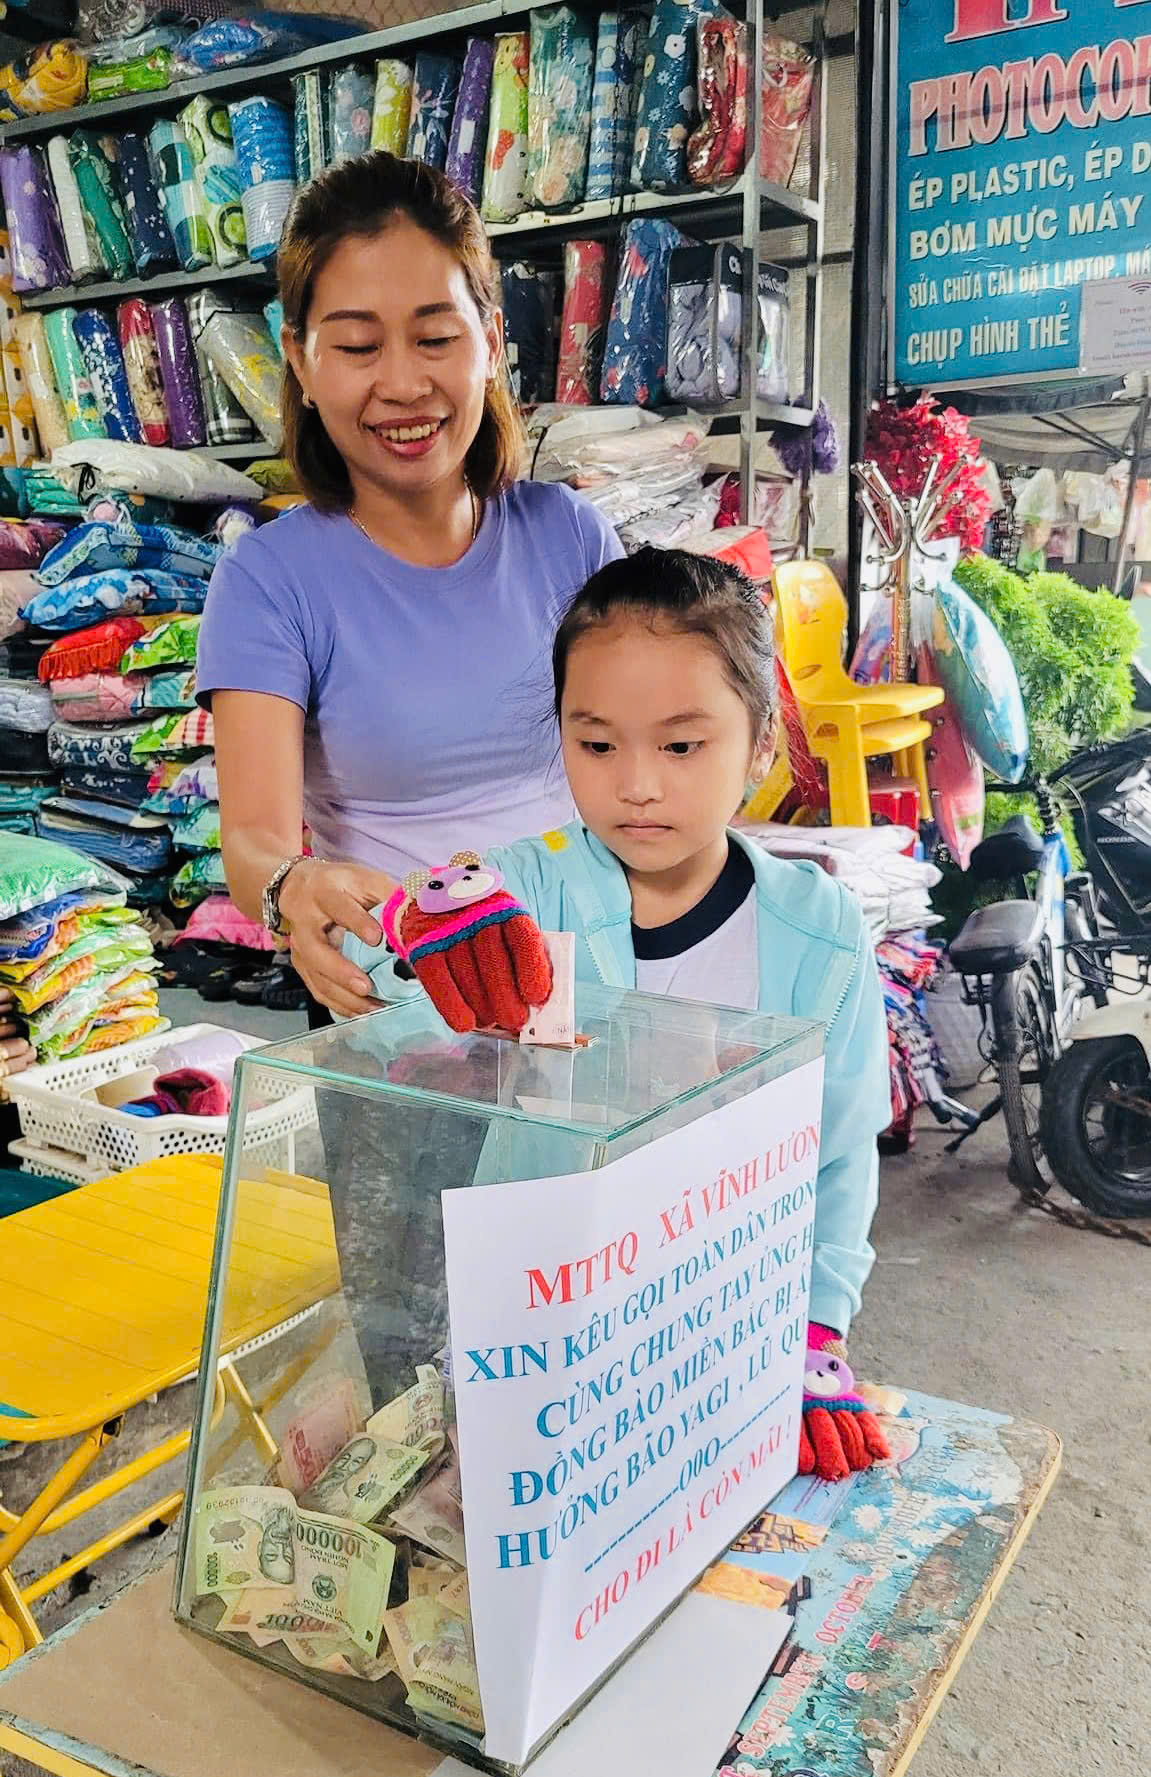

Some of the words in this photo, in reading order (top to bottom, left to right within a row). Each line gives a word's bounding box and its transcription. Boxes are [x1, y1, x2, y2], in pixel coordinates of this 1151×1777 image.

[908, 170, 943, 211] ÉP
[951, 155, 1074, 204] PLASTIC,
[1084, 140, 1123, 182] ÉP
[910, 219, 976, 260] BƠM
[986, 205, 1058, 252] MỰC
[1068, 191, 1144, 236] MÁY
[907, 327, 963, 370] CHỤP
[970, 316, 1020, 357] HÌNH
[1027, 301, 1069, 350] THẺ
[943, 271, 983, 304] CHỮA
[524, 1231, 639, 1309] MTTQ
[658, 1187, 694, 1248] XÃ
[701, 1156, 759, 1218] VĨNH
[464, 1341, 549, 1382] XIN
[561, 1307, 618, 1368] KÊU
[623, 1275, 665, 1325] GỌI
[671, 1236, 726, 1294] TOÀN
[730, 1209, 767, 1256] DÂN
[536, 1360, 623, 1438] CÙNG
[630, 1296, 713, 1377] CHUNG
[720, 1264, 755, 1313] TAY
[507, 1424, 606, 1507] ĐỒNG
[614, 1382, 665, 1444] BÀO
[671, 1331, 727, 1399] MIỀN
[732, 1298, 770, 1350] BẮC
[775, 1281, 791, 1316] BỊ
[495, 1469, 618, 1569] HƯỞNG
[626, 1425, 675, 1488] BÃO
[680, 1376, 729, 1438] YAGI
[749, 1336, 773, 1382] LŨ
[575, 1570, 629, 1640] CHO
